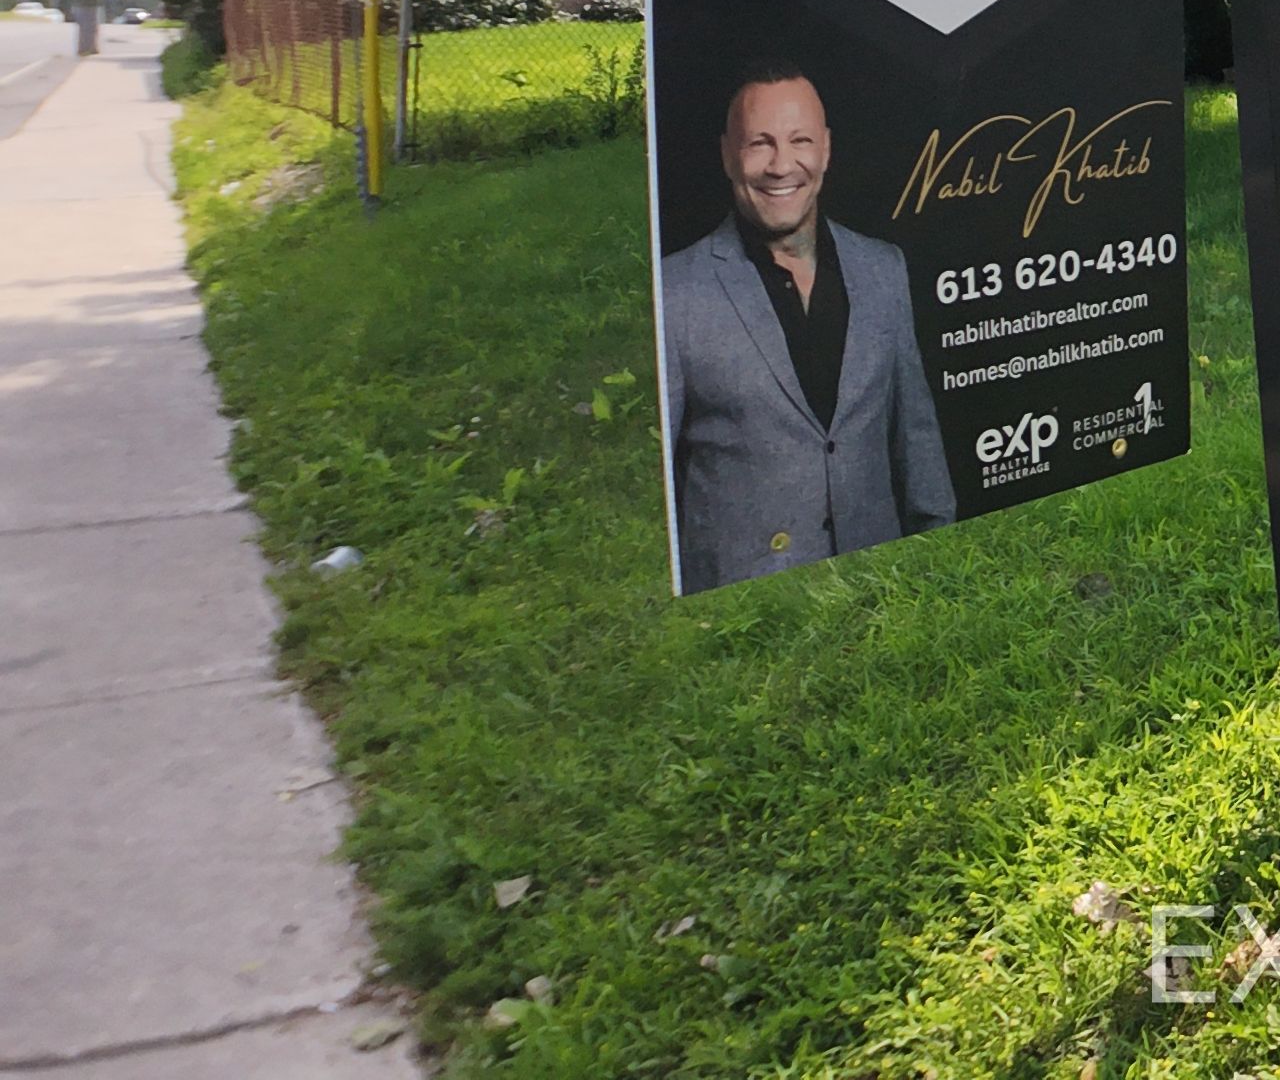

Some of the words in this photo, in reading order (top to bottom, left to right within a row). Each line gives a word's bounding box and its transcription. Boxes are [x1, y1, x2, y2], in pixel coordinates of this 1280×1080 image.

[892, 114, 1032, 220] Nabil
[1006, 100, 1173, 239] Khatib
[935, 263, 1002, 304] 613
[1014, 233, 1177, 290] 620-4340
[941, 291, 1149, 348] nabilkhatibrealtor.com
[942, 326, 1165, 391] homes@nabilkhatib.com
[982, 455, 1030, 476] REALTY
[983, 461, 1050, 489] BROKERAGE
